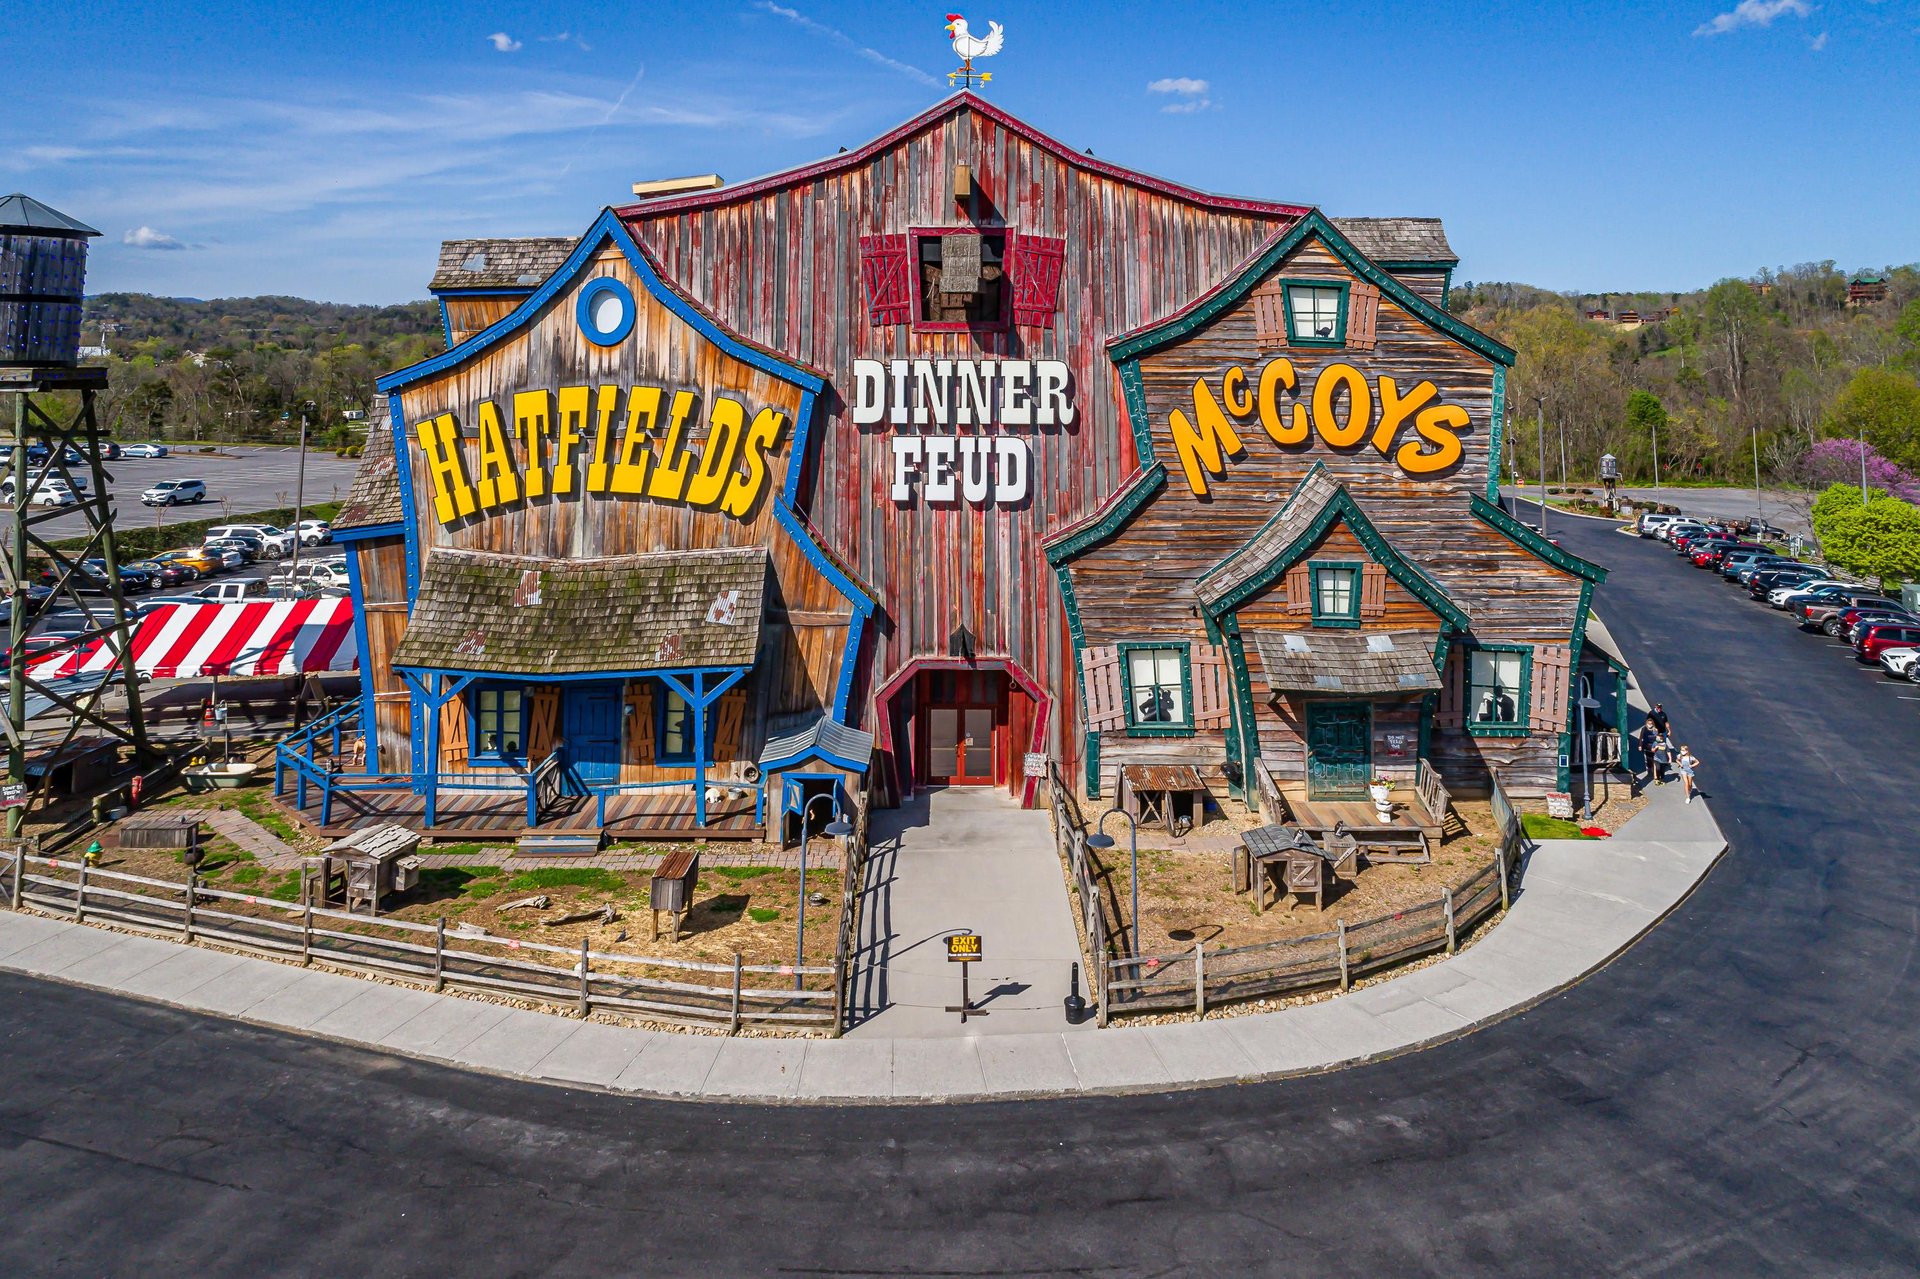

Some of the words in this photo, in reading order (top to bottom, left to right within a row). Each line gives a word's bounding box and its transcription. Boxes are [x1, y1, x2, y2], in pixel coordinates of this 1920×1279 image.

[852, 359, 1075, 425] DINNER
[415, 384, 784, 525] HATFIELDS
[891, 436, 1028, 503] FEUD
[951, 944, 978, 953] ONLY
[952, 936, 977, 945] EXIT
